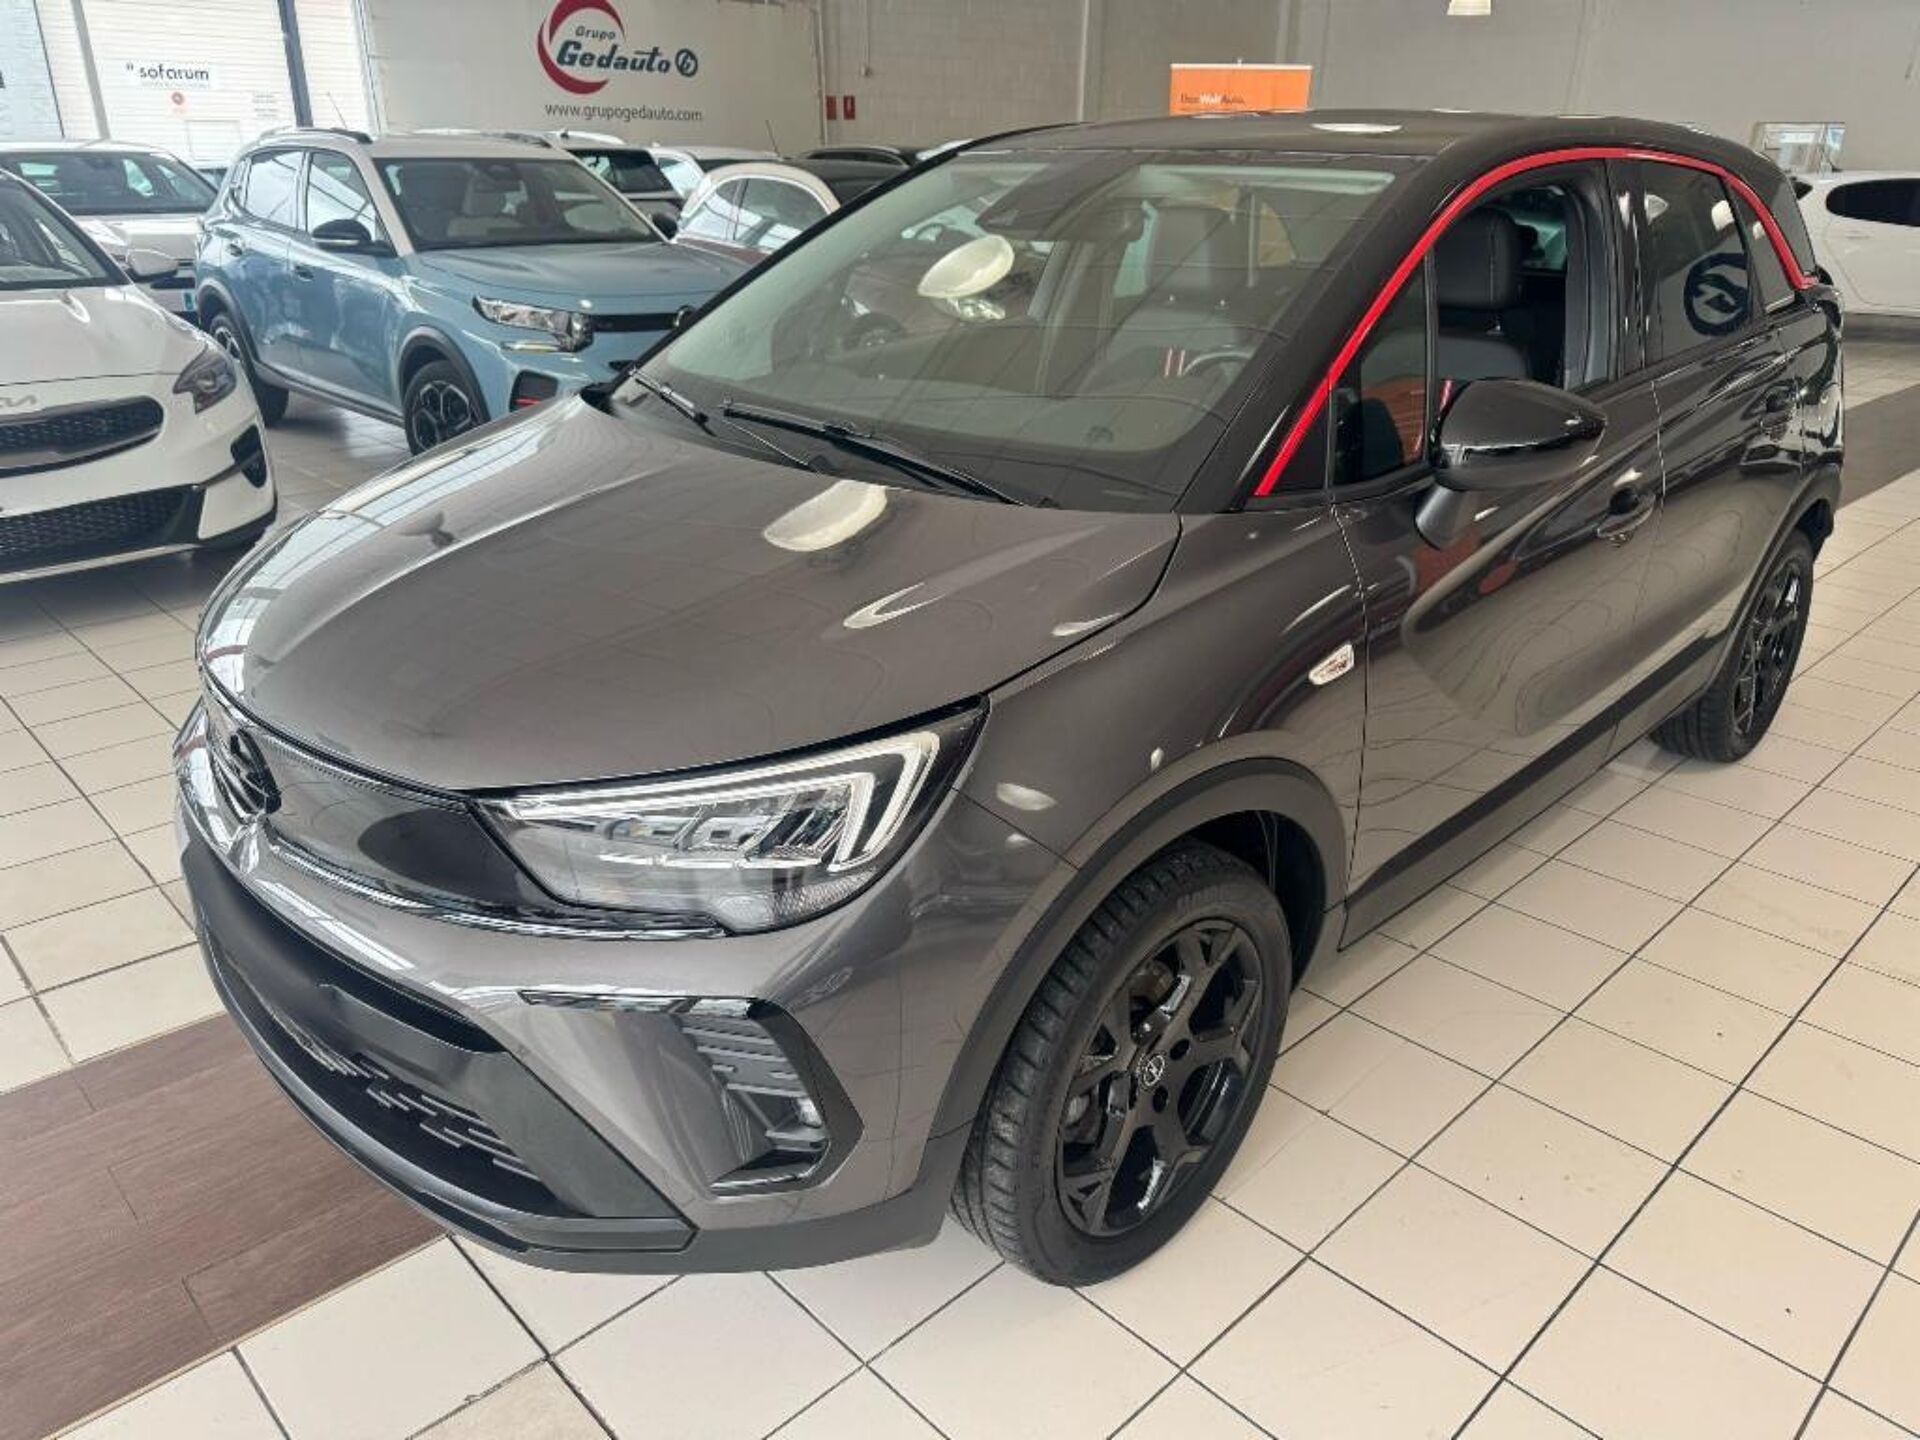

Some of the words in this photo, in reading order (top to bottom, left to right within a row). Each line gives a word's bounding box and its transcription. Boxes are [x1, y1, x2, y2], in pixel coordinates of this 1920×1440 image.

[575, 26, 616, 41] Grupo
[557, 40, 671, 74] Gedauto
[545, 104, 703, 122] www.grupogedauto.com
